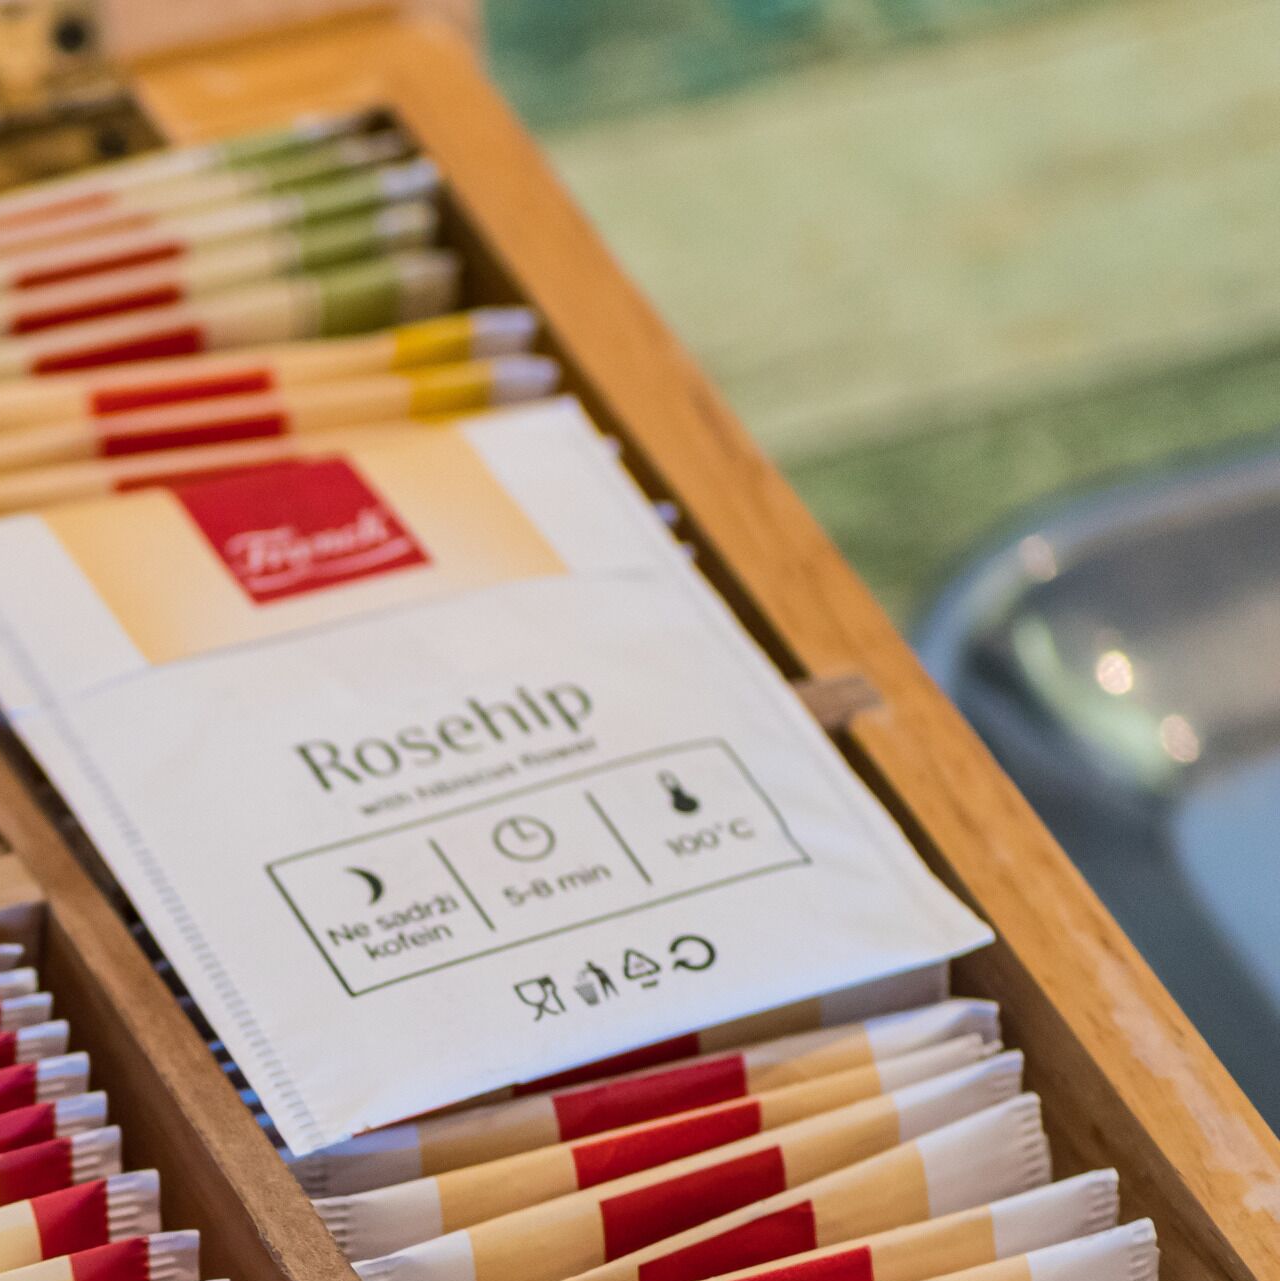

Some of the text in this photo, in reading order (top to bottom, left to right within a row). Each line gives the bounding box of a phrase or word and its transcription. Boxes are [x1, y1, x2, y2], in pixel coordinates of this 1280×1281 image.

[294, 682, 593, 791] Rosehip
[557, 862, 613, 892] min
[327, 924, 372, 946] Ne
[362, 923, 455, 961] kofein
